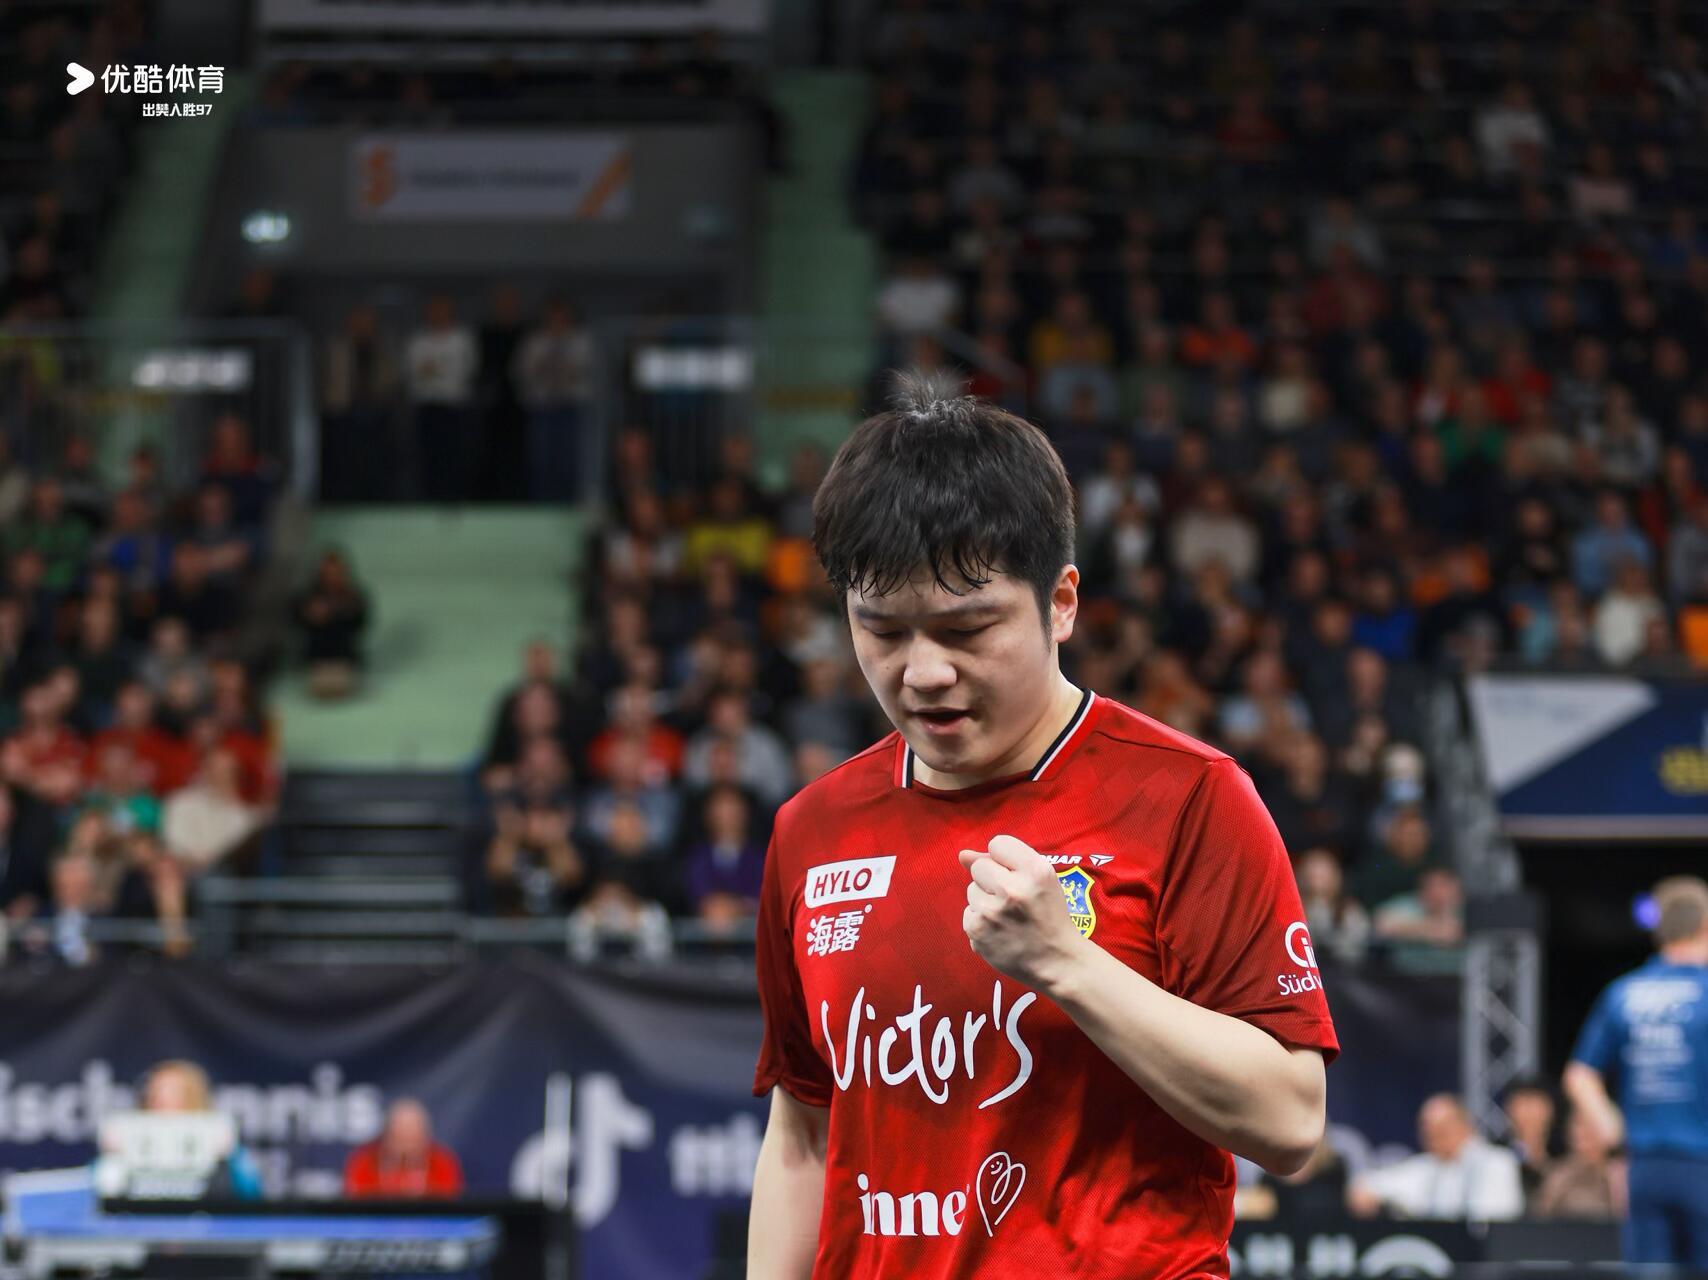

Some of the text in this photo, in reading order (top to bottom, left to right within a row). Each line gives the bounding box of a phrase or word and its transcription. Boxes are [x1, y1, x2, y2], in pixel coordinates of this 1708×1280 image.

[813, 867, 873, 899] HYLO
[806, 910, 864, 957] 海露
[821, 979, 1037, 1110] Victor's
[857, 1173, 968, 1236] inne
